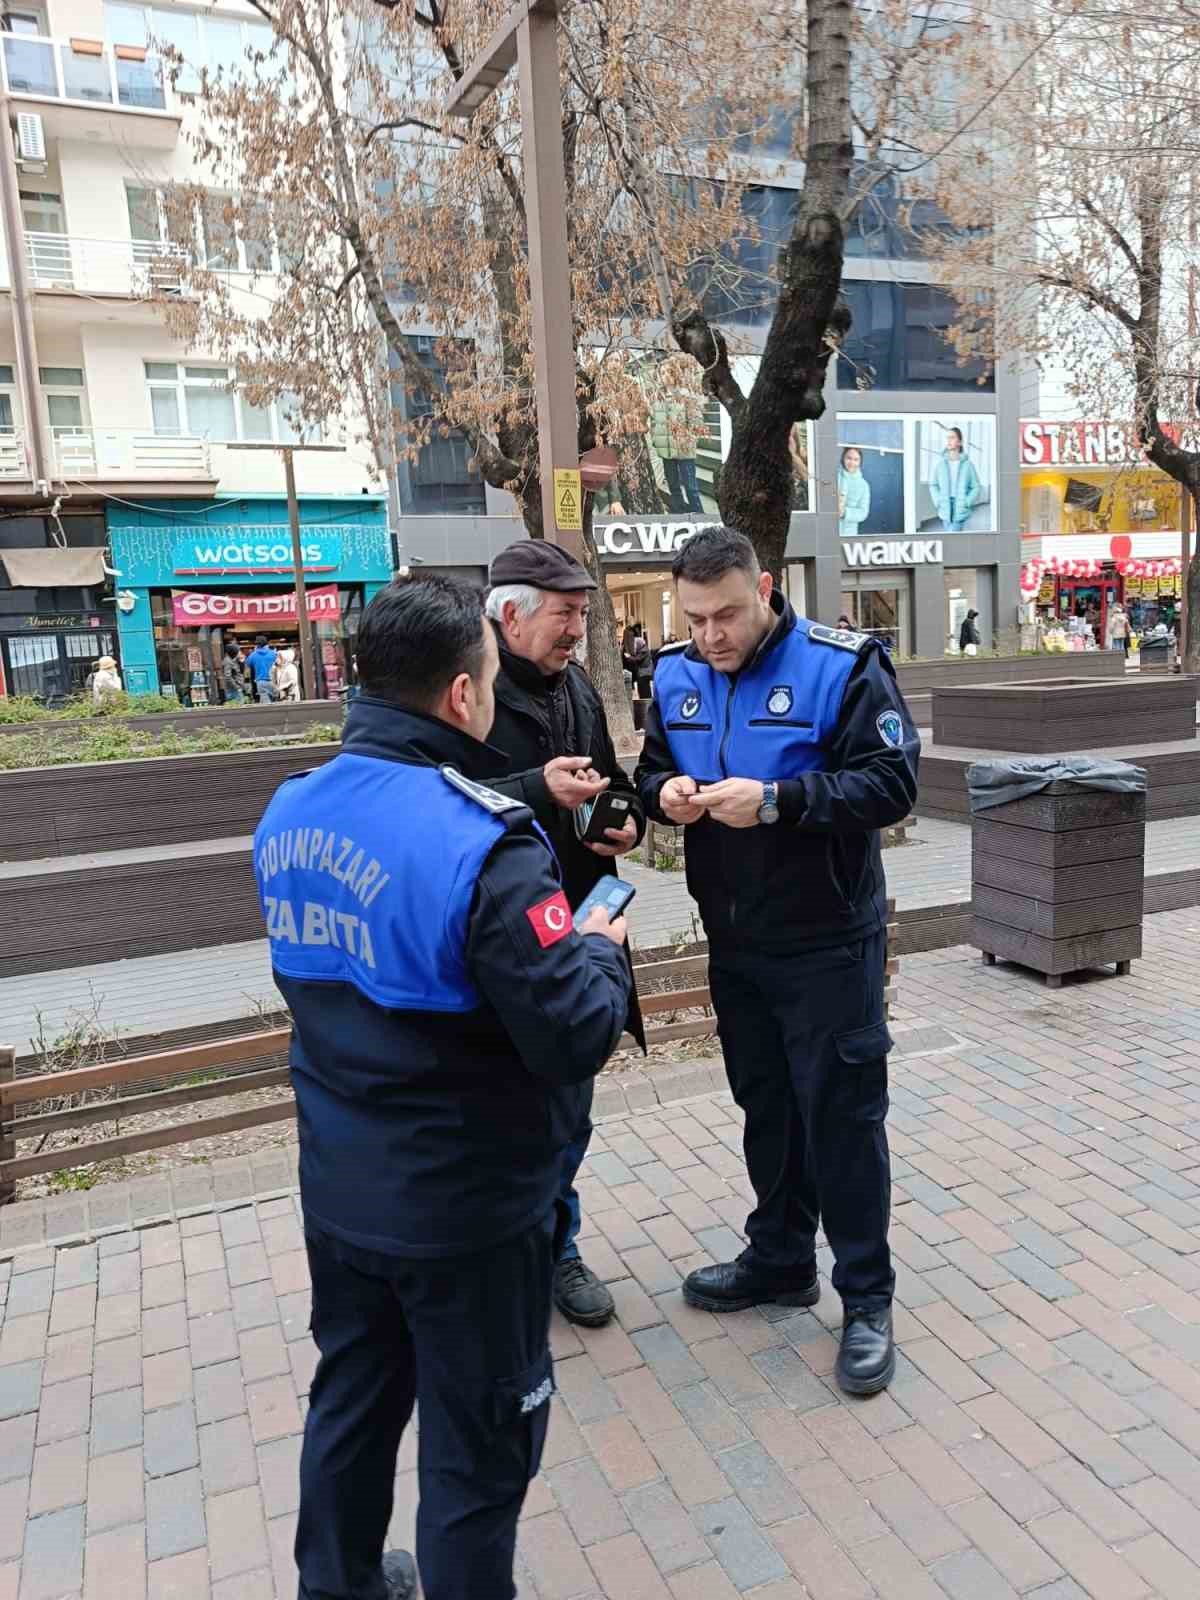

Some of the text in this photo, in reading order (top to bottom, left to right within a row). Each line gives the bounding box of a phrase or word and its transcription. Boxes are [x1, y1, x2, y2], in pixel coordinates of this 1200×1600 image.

[194, 543, 322, 563] watsons
[842, 540, 943, 566] waikiki
[258, 827, 391, 909] ODUNPAZARI
[264, 896, 377, 969] ZABITA
